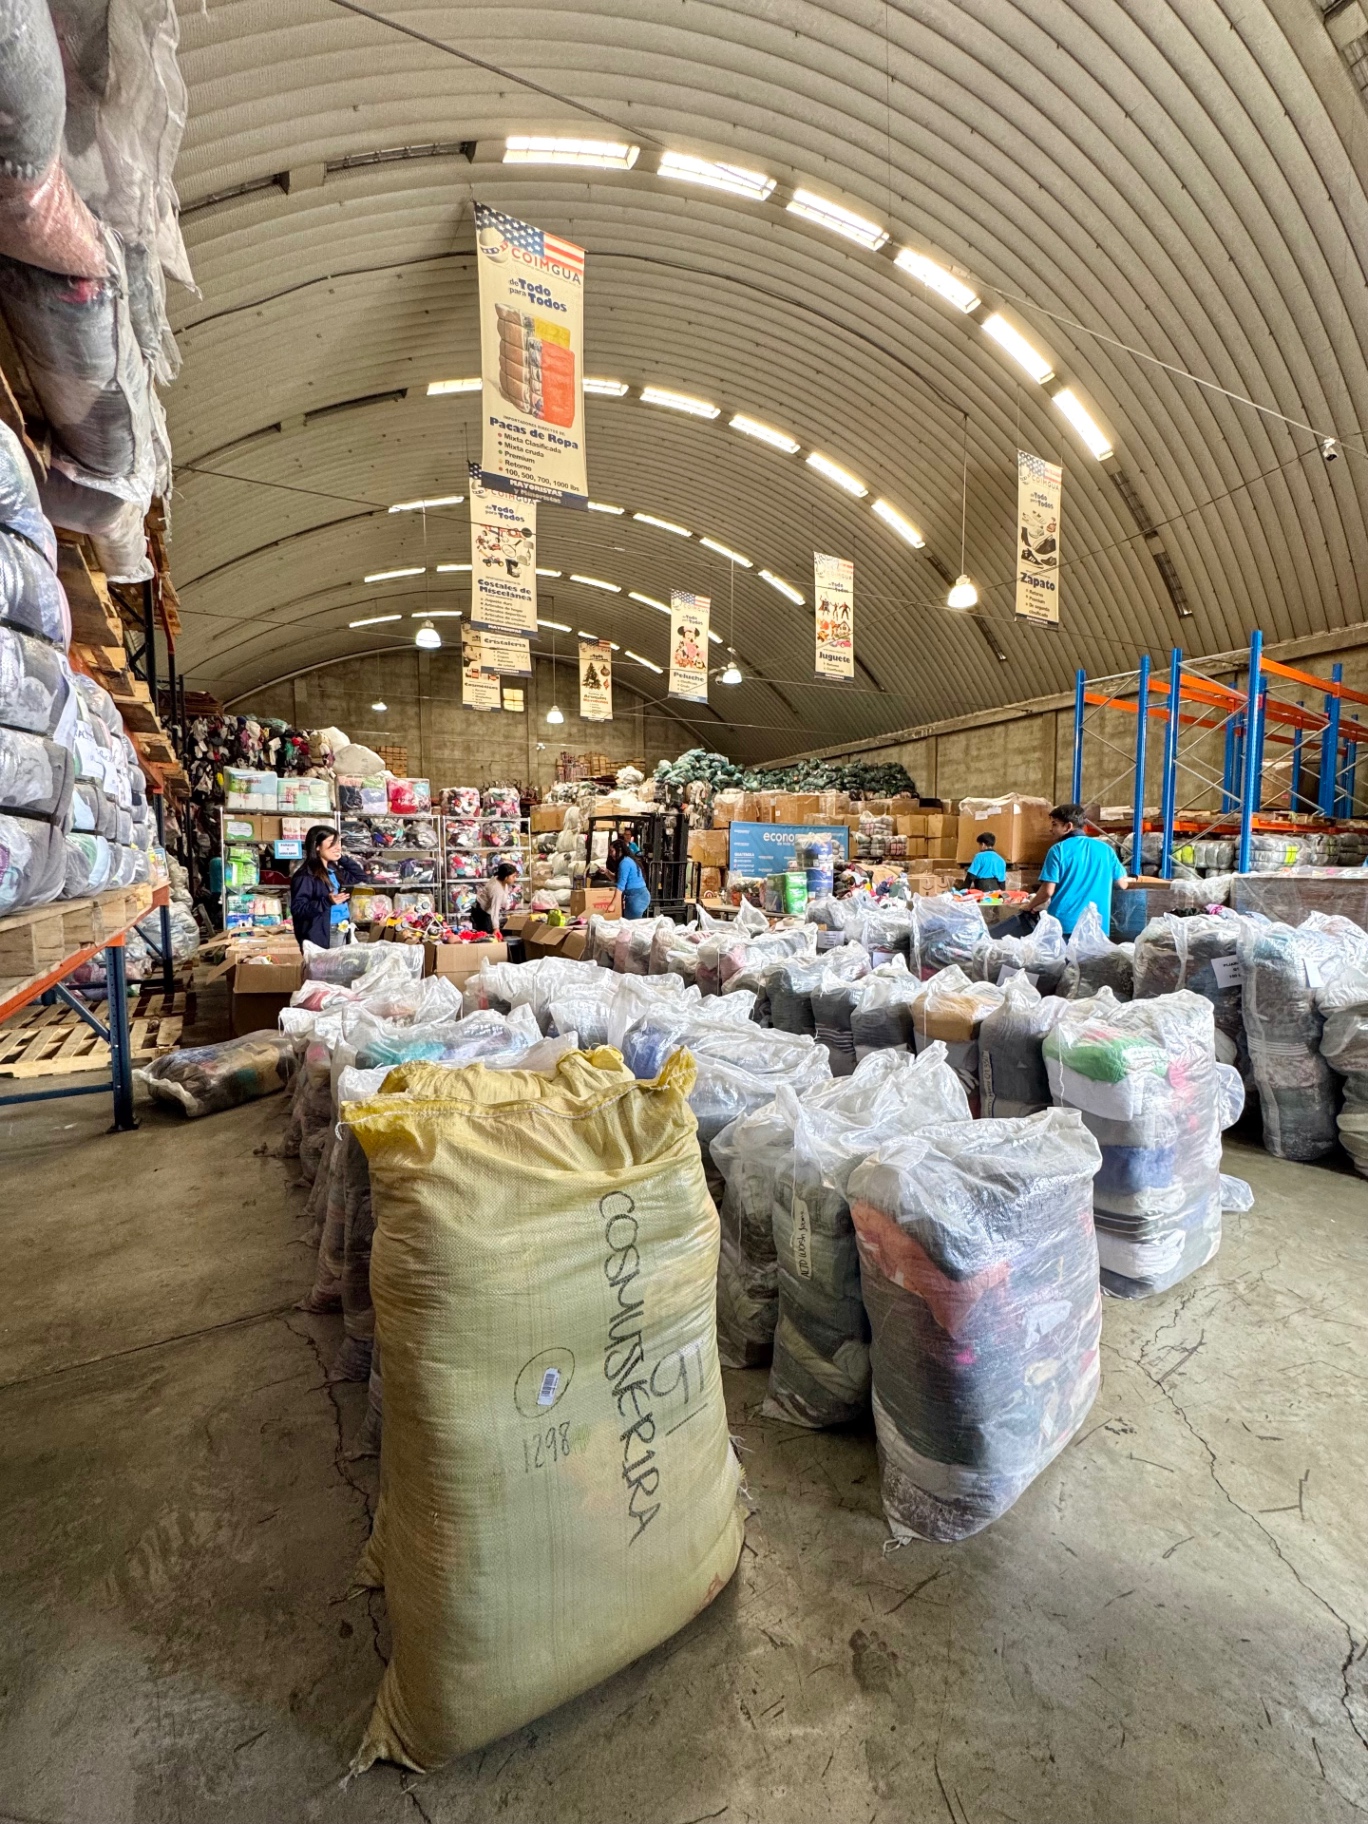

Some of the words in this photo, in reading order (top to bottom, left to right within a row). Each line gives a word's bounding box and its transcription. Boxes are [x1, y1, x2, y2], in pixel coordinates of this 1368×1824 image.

[511, 246, 581, 285] COIMGUA
[509, 278, 519, 287] de
[518, 278, 551, 297] Todo
[509, 286, 526, 297] para
[528, 293, 567, 313] Todos
[489, 417, 526, 435] Pacas
[529, 429, 545, 440] de
[548, 433, 579, 450] Ropa
[504, 432, 523, 443] Mixta
[525, 439, 562, 454] Clasificada
[504, 441, 523, 452] Mixta
[525, 448, 544, 458] cruda
[504, 450, 535, 464] Premium
[504, 460, 532, 471] Retorno
[505, 468, 520, 478] 100,
[521, 472, 536, 482] 500,
[538, 476, 552, 486] 700,
[553, 480, 569, 489] 1000
[570, 484, 580, 492] lbs
[510, 479, 563, 497] MAYORISTAS
[1034, 492, 1048, 500] Todo
[1038, 500, 1054, 509] Todos
[491, 504, 514, 514] Todo
[498, 512, 525, 522] Todos
[478, 578, 518, 592] Costales
[519, 587, 531, 595] de
[1020, 571, 1055, 591] Zapato
[819, 651, 850, 664] Juguete
[673, 671, 704, 683] Peluche
[523, 1421, 571, 1473] 1298
